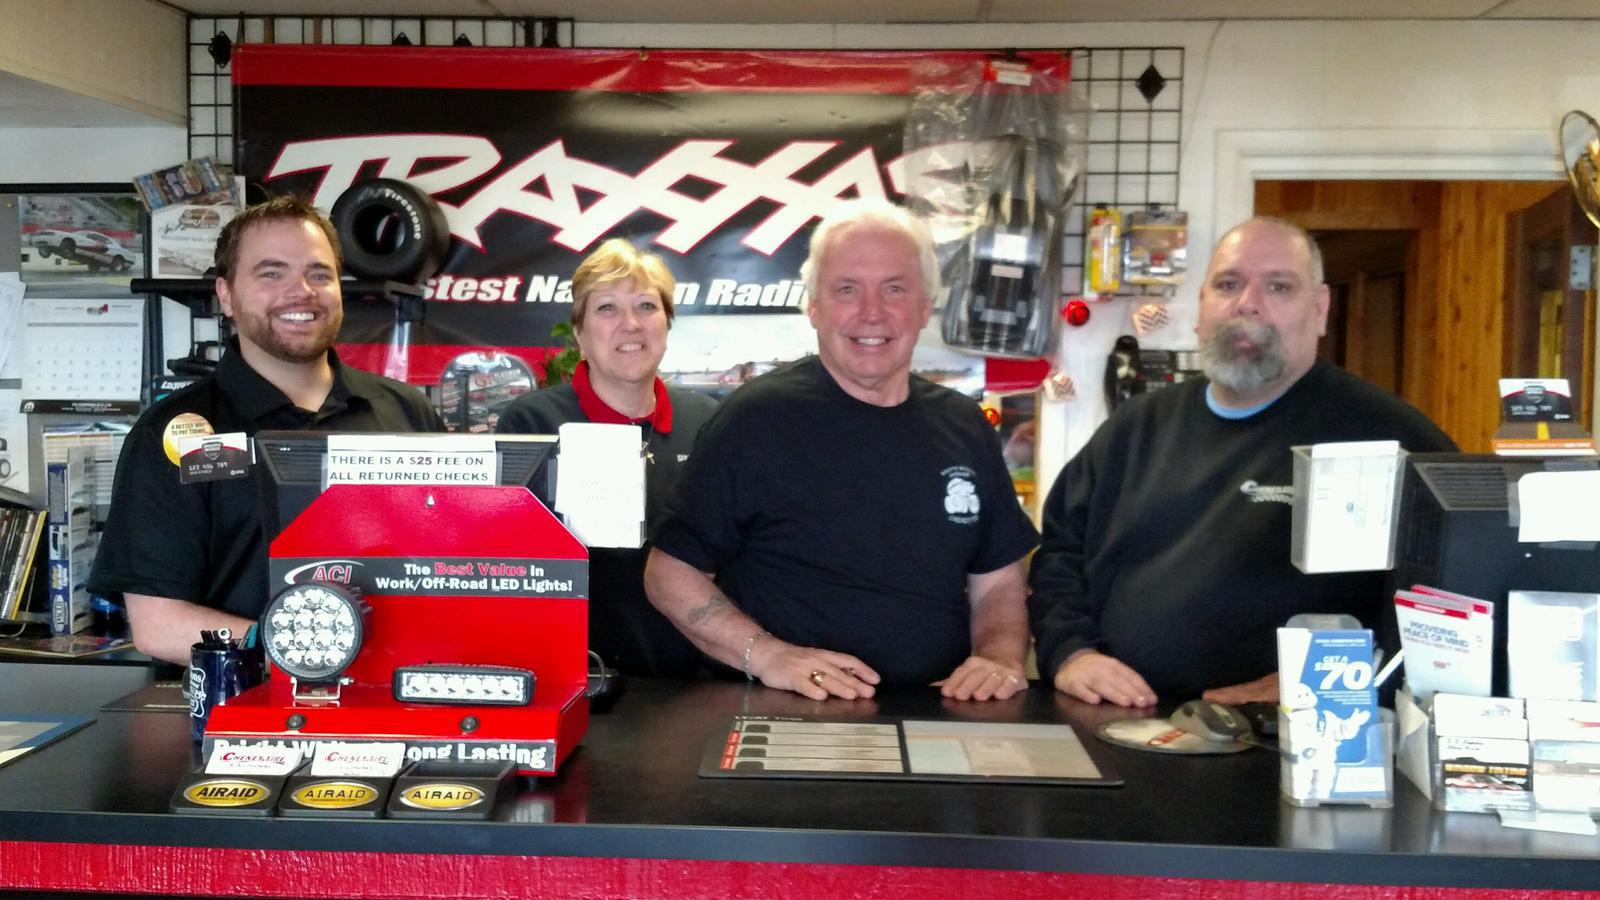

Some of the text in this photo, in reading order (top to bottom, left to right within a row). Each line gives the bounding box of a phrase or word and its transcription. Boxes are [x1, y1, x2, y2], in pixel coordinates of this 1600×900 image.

[385, 188, 421, 240] Firestone
[525, 275, 573, 303] Na
[706, 278, 807, 308] Radi
[331, 455, 484, 466] THERE IS A $25 FEE ON
[330, 471, 489, 481] ALL RETURNED CHECKS
[312, 565, 353, 584] ACI
[403, 562, 544, 577] The Best Value in
[375, 577, 573, 593] Work/Off-Road LED Lights!
[457, 743, 547, 769] Lasting
[196, 786, 259, 798] AIRAID
[304, 789, 367, 799] AIRAID
[412, 790, 474, 800] AIRAID
